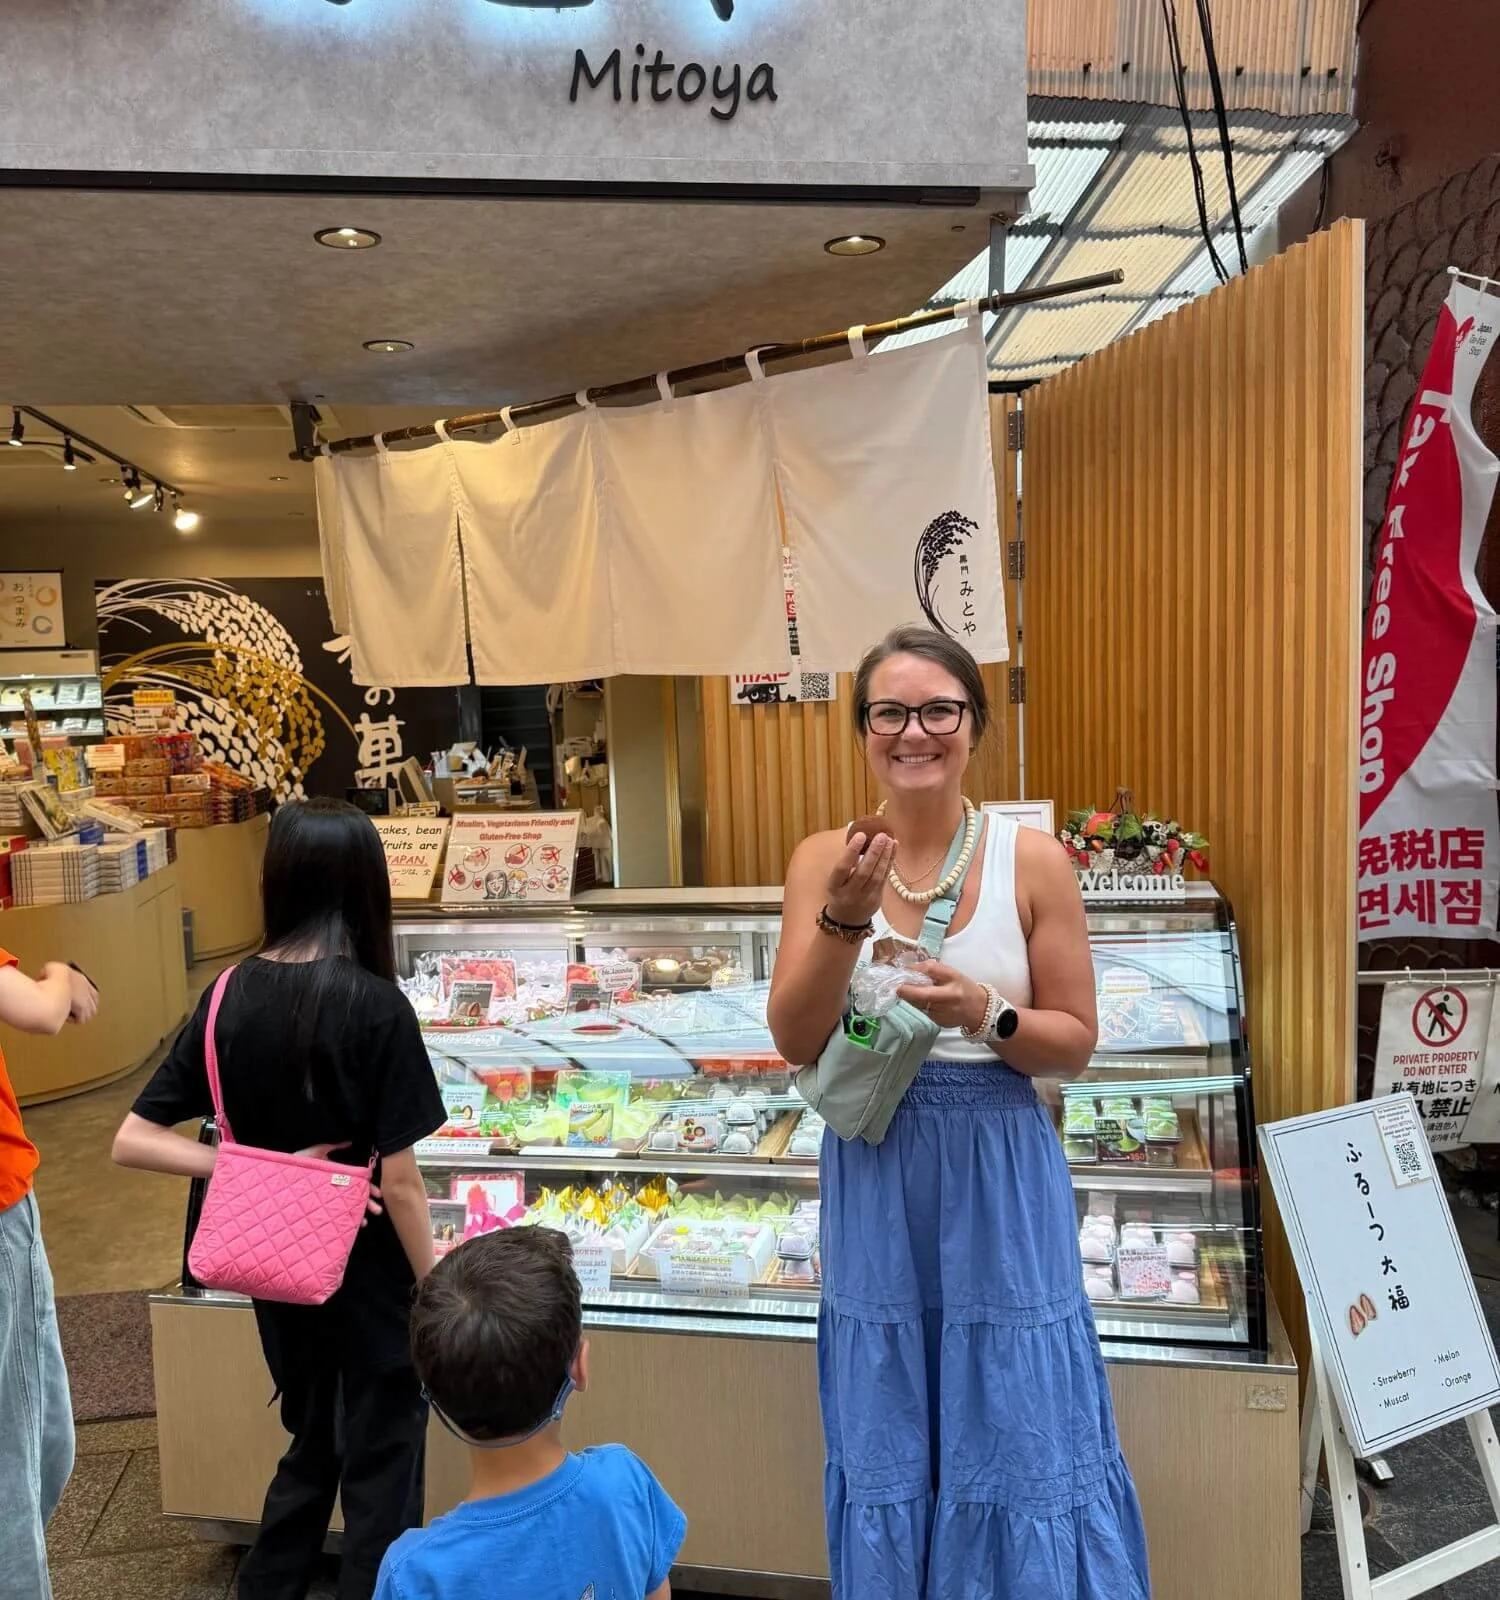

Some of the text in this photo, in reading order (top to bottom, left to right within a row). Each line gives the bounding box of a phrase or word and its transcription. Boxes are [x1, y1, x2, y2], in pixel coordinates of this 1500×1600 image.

[569, 43, 778, 121] Mitoya
[959, 580, 977, 637] みとや
[1360, 651, 1397, 795] Shop
[415, 825, 442, 835] bean
[531, 818, 560, 828] Friendly
[560, 817, 576, 826] and
[479, 832, 543, 841] Gluten-Free Shop
[419, 842, 439, 850] are
[1359, 827, 1485, 879] 免税店
[1076, 868, 1186, 892] Welcome
[1359, 878, 1483, 930] 면세점
[1393, 1050, 1480, 1065] PRIVATE PROPERTY
[1403, 1064, 1467, 1077] DO NOT ENTER
[1391, 1079, 1477, 1096] 私有地につき
[1346, 1142, 1411, 1312] ふるーつ大福
[1437, 1349, 1461, 1365] Melon
[1376, 1366, 1417, 1389] Strawberry
[1444, 1372, 1473, 1389] Orange
[1383, 1392, 1411, 1409] Muscat
